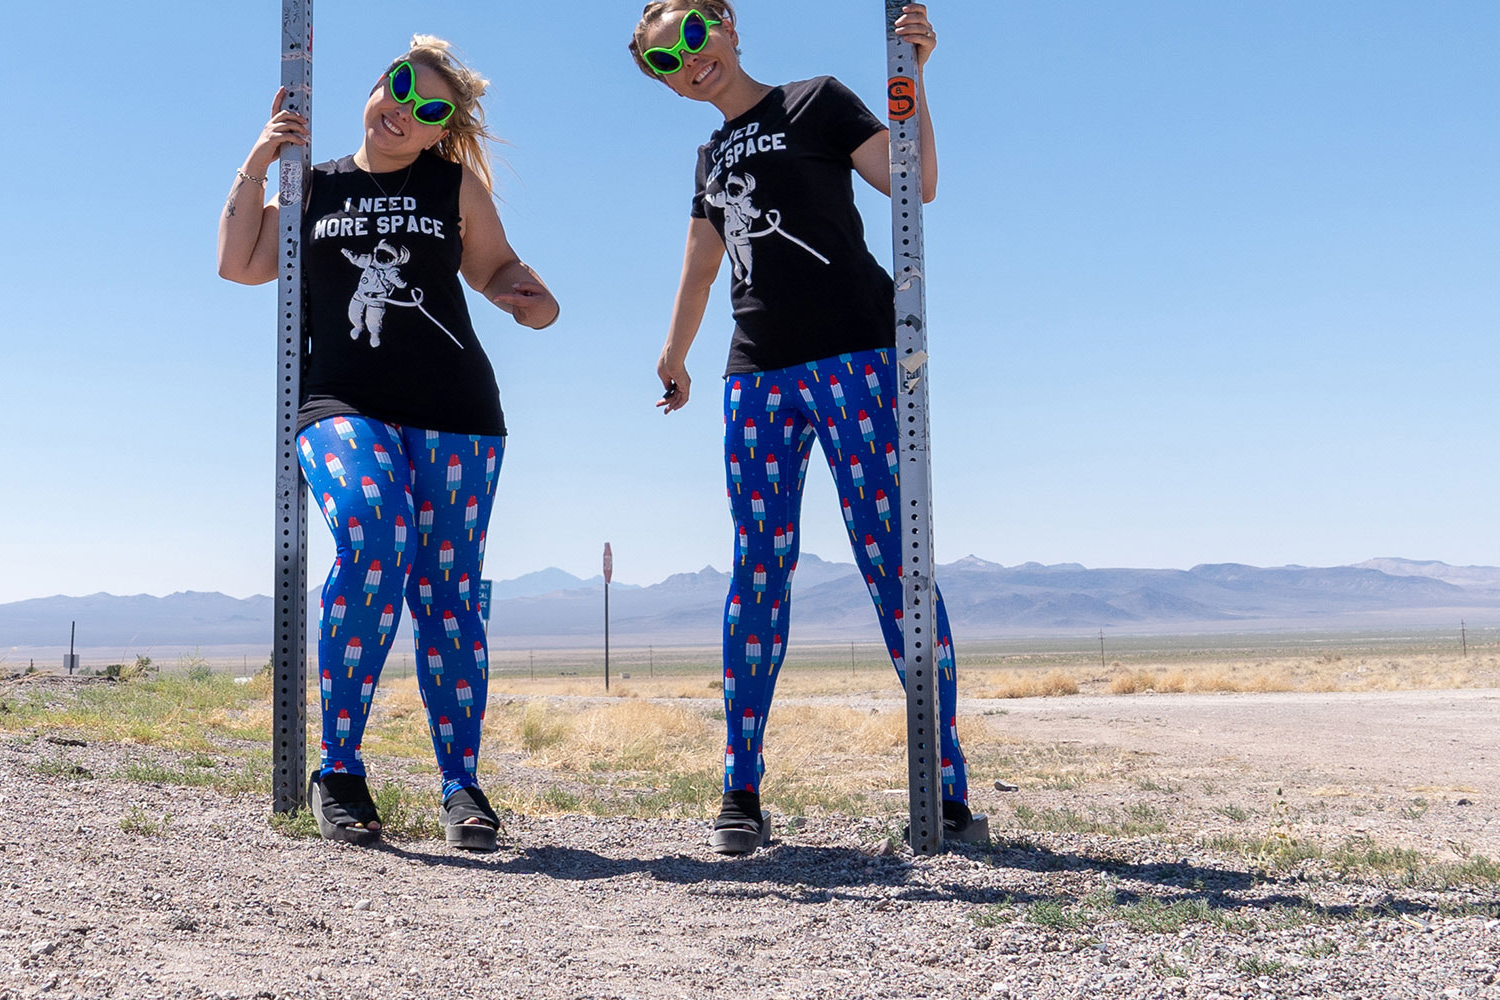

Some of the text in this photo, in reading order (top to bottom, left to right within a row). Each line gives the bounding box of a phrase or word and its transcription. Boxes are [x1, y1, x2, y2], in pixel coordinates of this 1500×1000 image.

[725, 132, 787, 168] SPACE
[344, 196, 417, 213] I NEED
[314, 215, 445, 240] MORE SPACE
